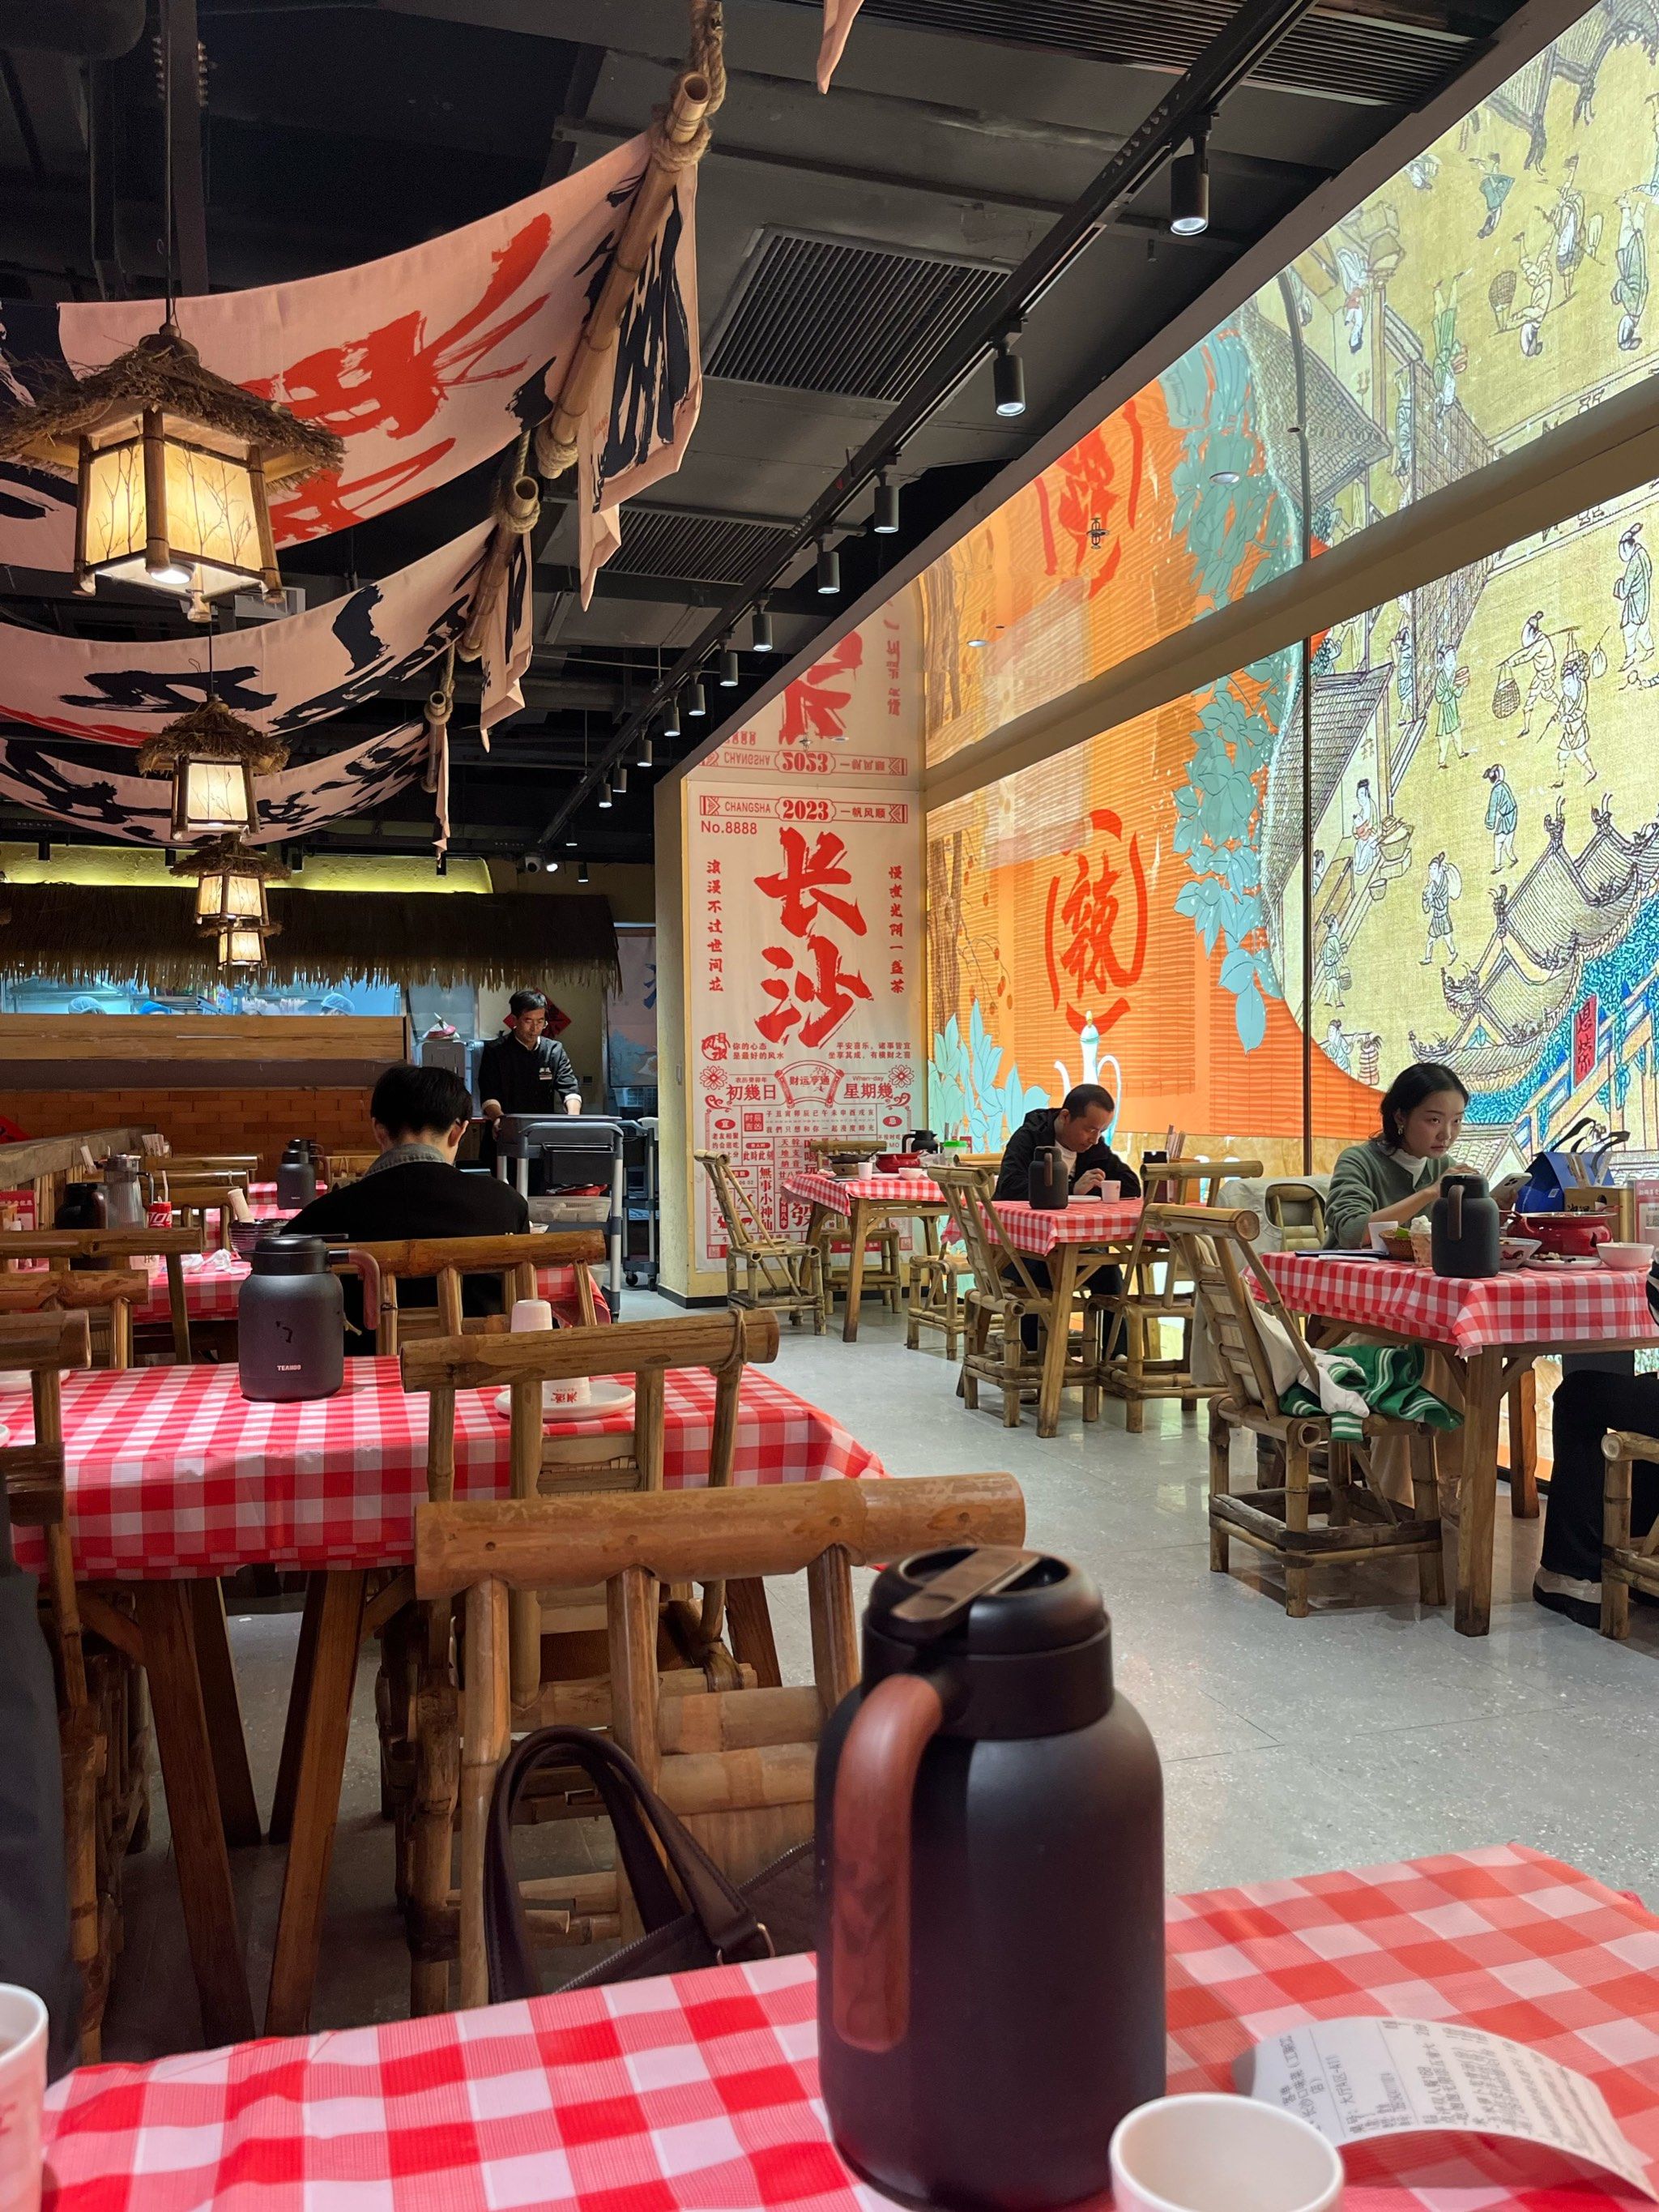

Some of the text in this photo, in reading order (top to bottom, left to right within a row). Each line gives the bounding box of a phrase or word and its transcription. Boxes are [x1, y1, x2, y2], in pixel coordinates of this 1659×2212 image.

[724, 801, 771, 813] CHANGSHA
[783, 799, 830, 821] 2023
[840, 806, 886, 819] 一帆风顺
[701, 820, 758, 835] No.8888
[753, 826, 874, 1049] 长沙
[732, 1042, 767, 1050] 你的心态
[732, 1052, 784, 1060] 是最好的风水
[726, 1084, 776, 1100] 初幾日
[843, 1083, 893, 1100] 星期幾
